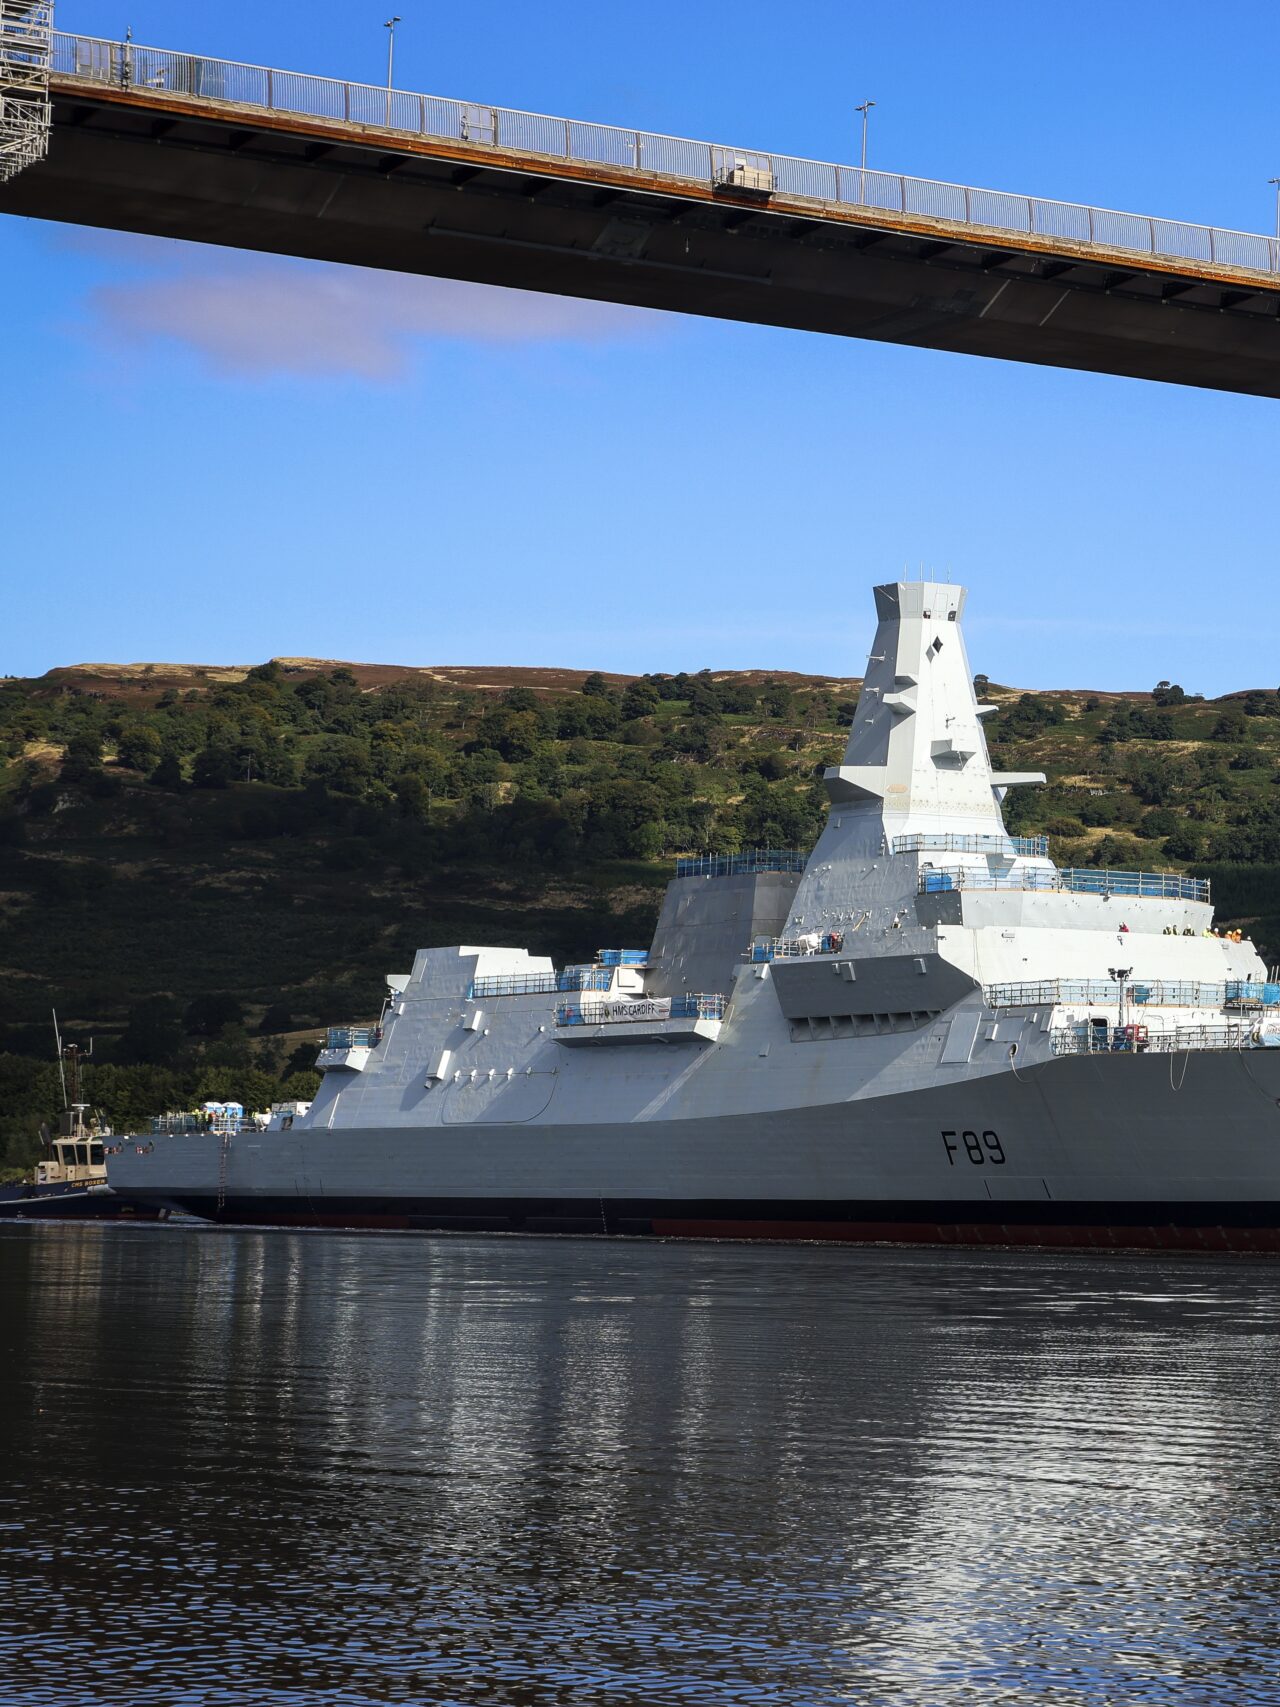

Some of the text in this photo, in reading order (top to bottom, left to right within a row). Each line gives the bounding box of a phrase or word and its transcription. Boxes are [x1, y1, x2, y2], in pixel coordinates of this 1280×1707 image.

[612, 1003, 655, 1016] HMS CARDIFF
[941, 1130, 1006, 1166] F89
